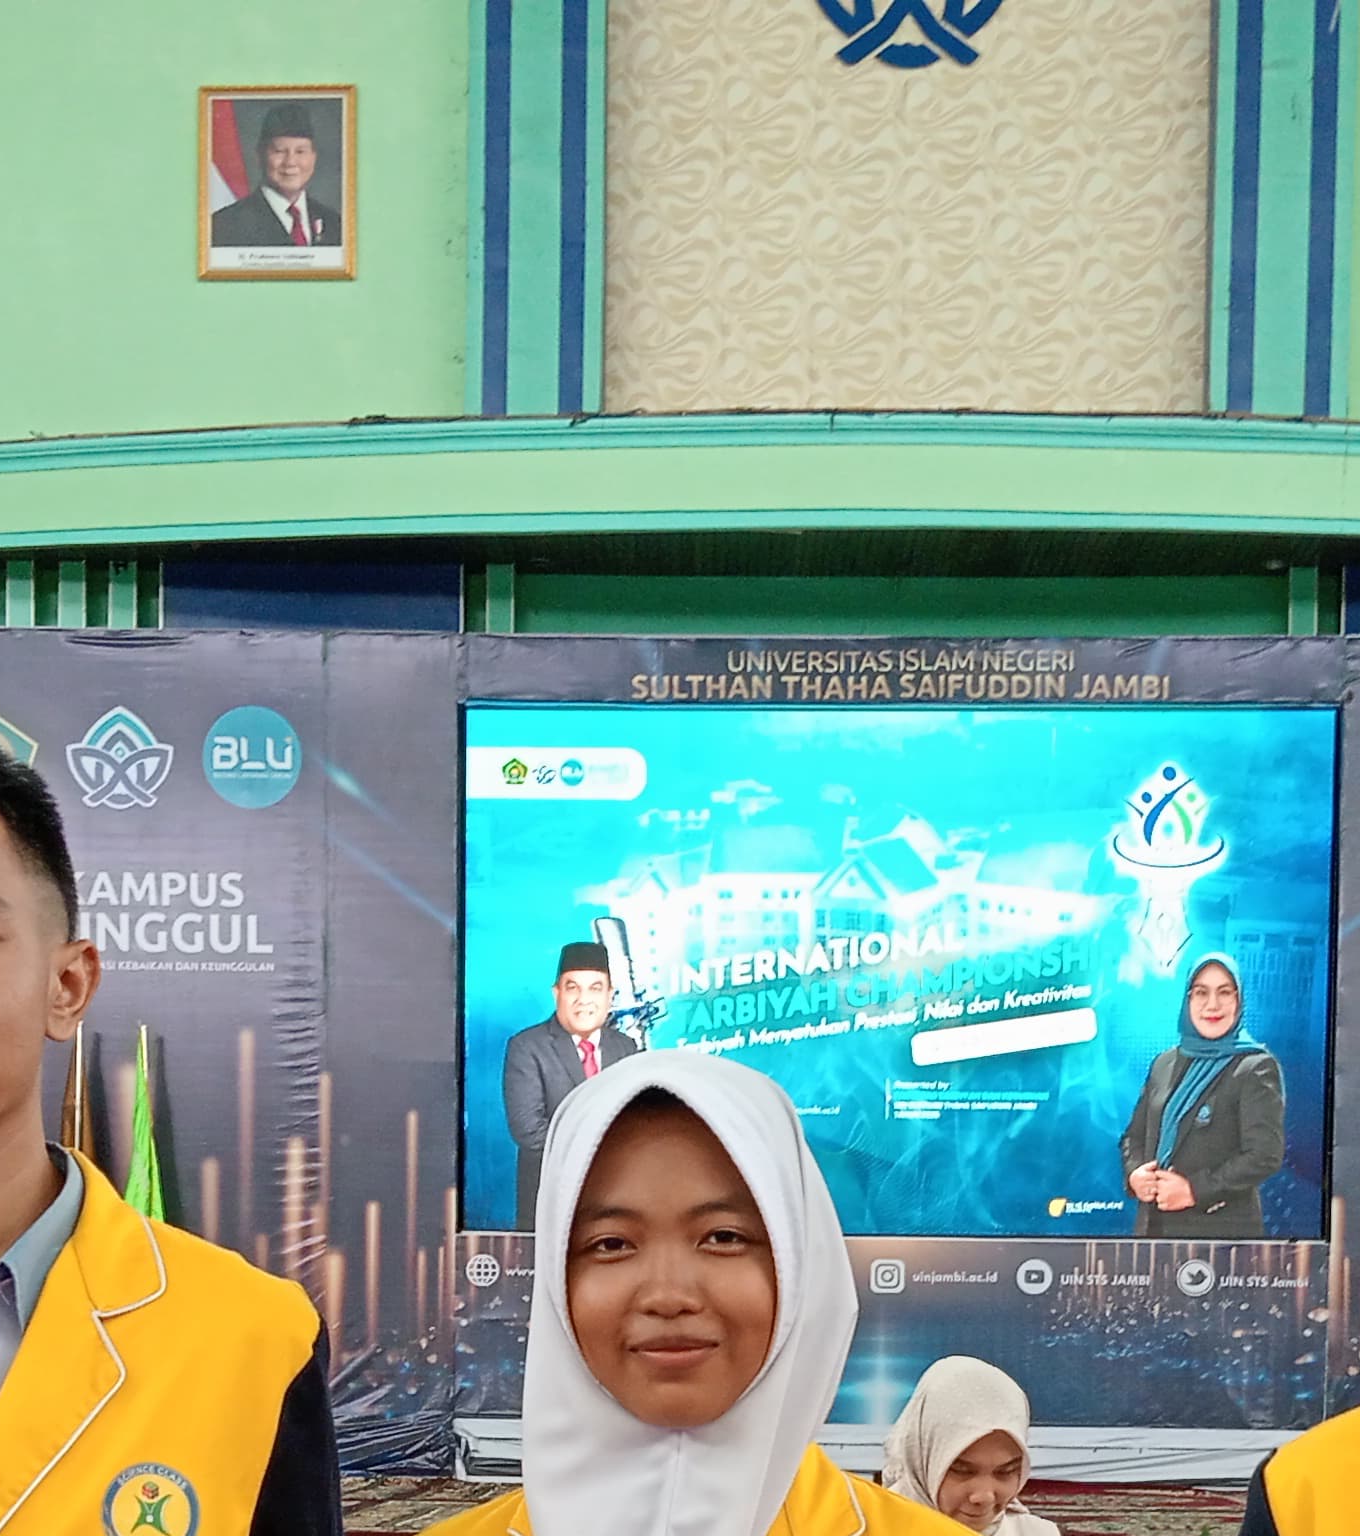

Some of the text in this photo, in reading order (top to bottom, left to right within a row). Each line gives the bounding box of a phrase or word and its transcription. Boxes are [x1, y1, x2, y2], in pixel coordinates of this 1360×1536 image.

[727, 649, 1076, 673] UNIVERSITAS ISLAM NEGERI
[631, 673, 1171, 700] SULTHAN THAHA SAIFUDDIN JAMBI
[175, 962, 199, 972] DAN
[673, 923, 966, 995] INTERNATIONAL
[676, 979, 839, 1033] TARBIYAH
[967, 995, 1000, 1015] dan
[912, 1270, 999, 1285] uinjambi.ac.id
[1060, 1273, 1151, 1287] UIN STS JAMBI
[1218, 1276, 1309, 1289] UIN STS Jambi
